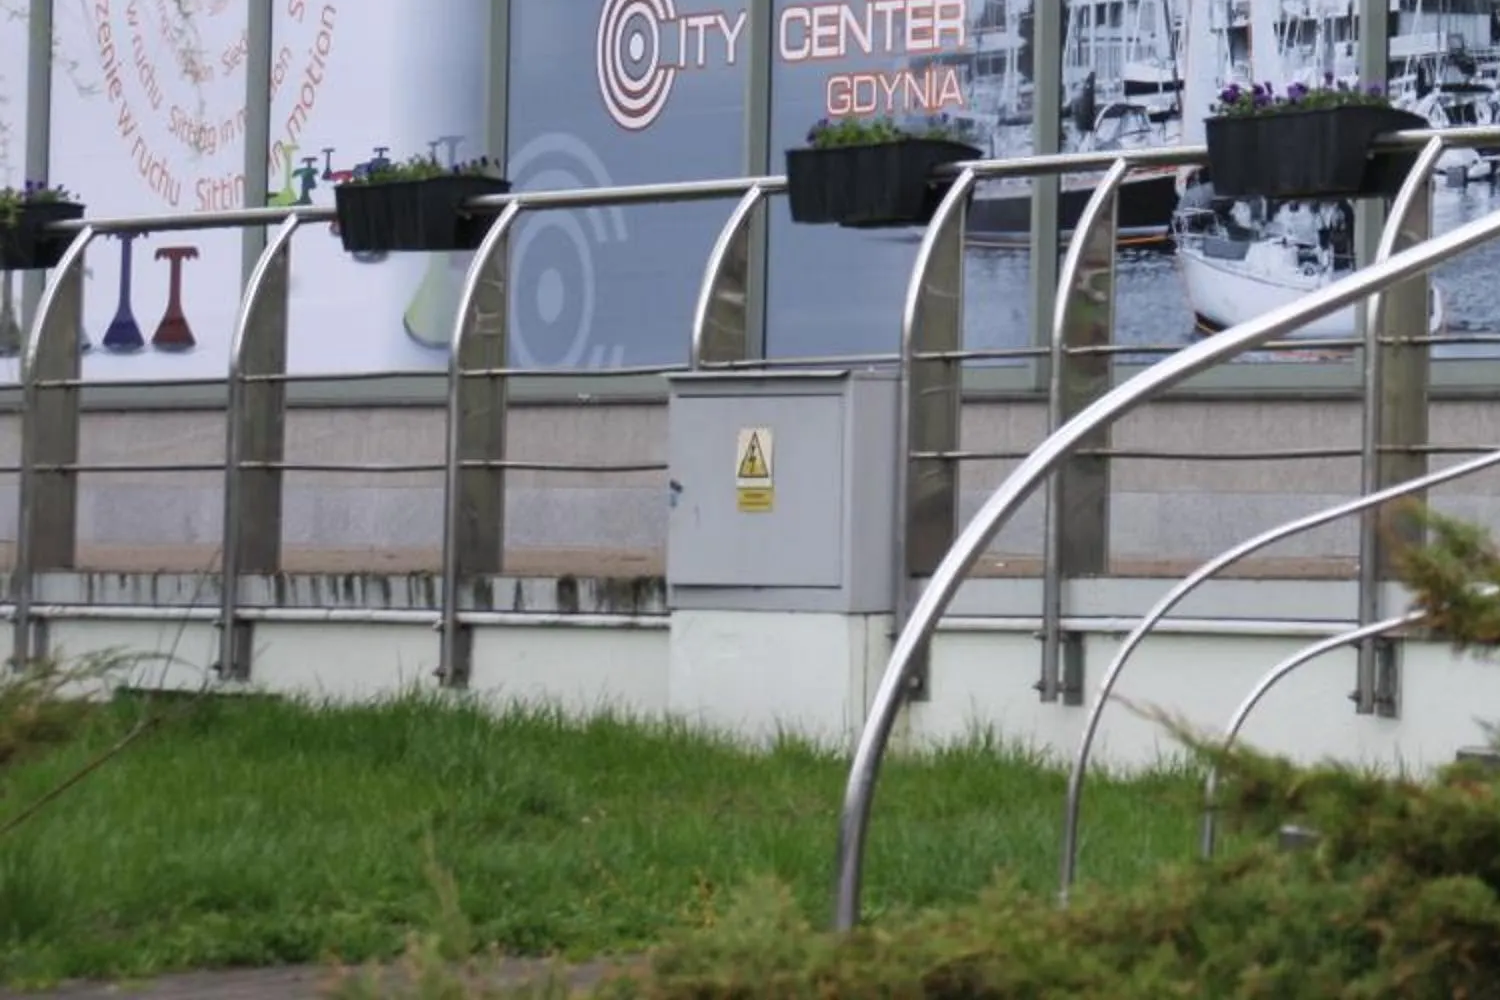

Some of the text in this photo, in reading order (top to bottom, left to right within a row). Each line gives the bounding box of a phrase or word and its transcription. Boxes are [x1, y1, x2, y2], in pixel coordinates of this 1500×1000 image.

[131, 135, 183, 207] ruchu
[194, 171, 247, 212] Sittin
[284, 3, 338, 146] motion
[825, 67, 966, 117] GDYNIA
